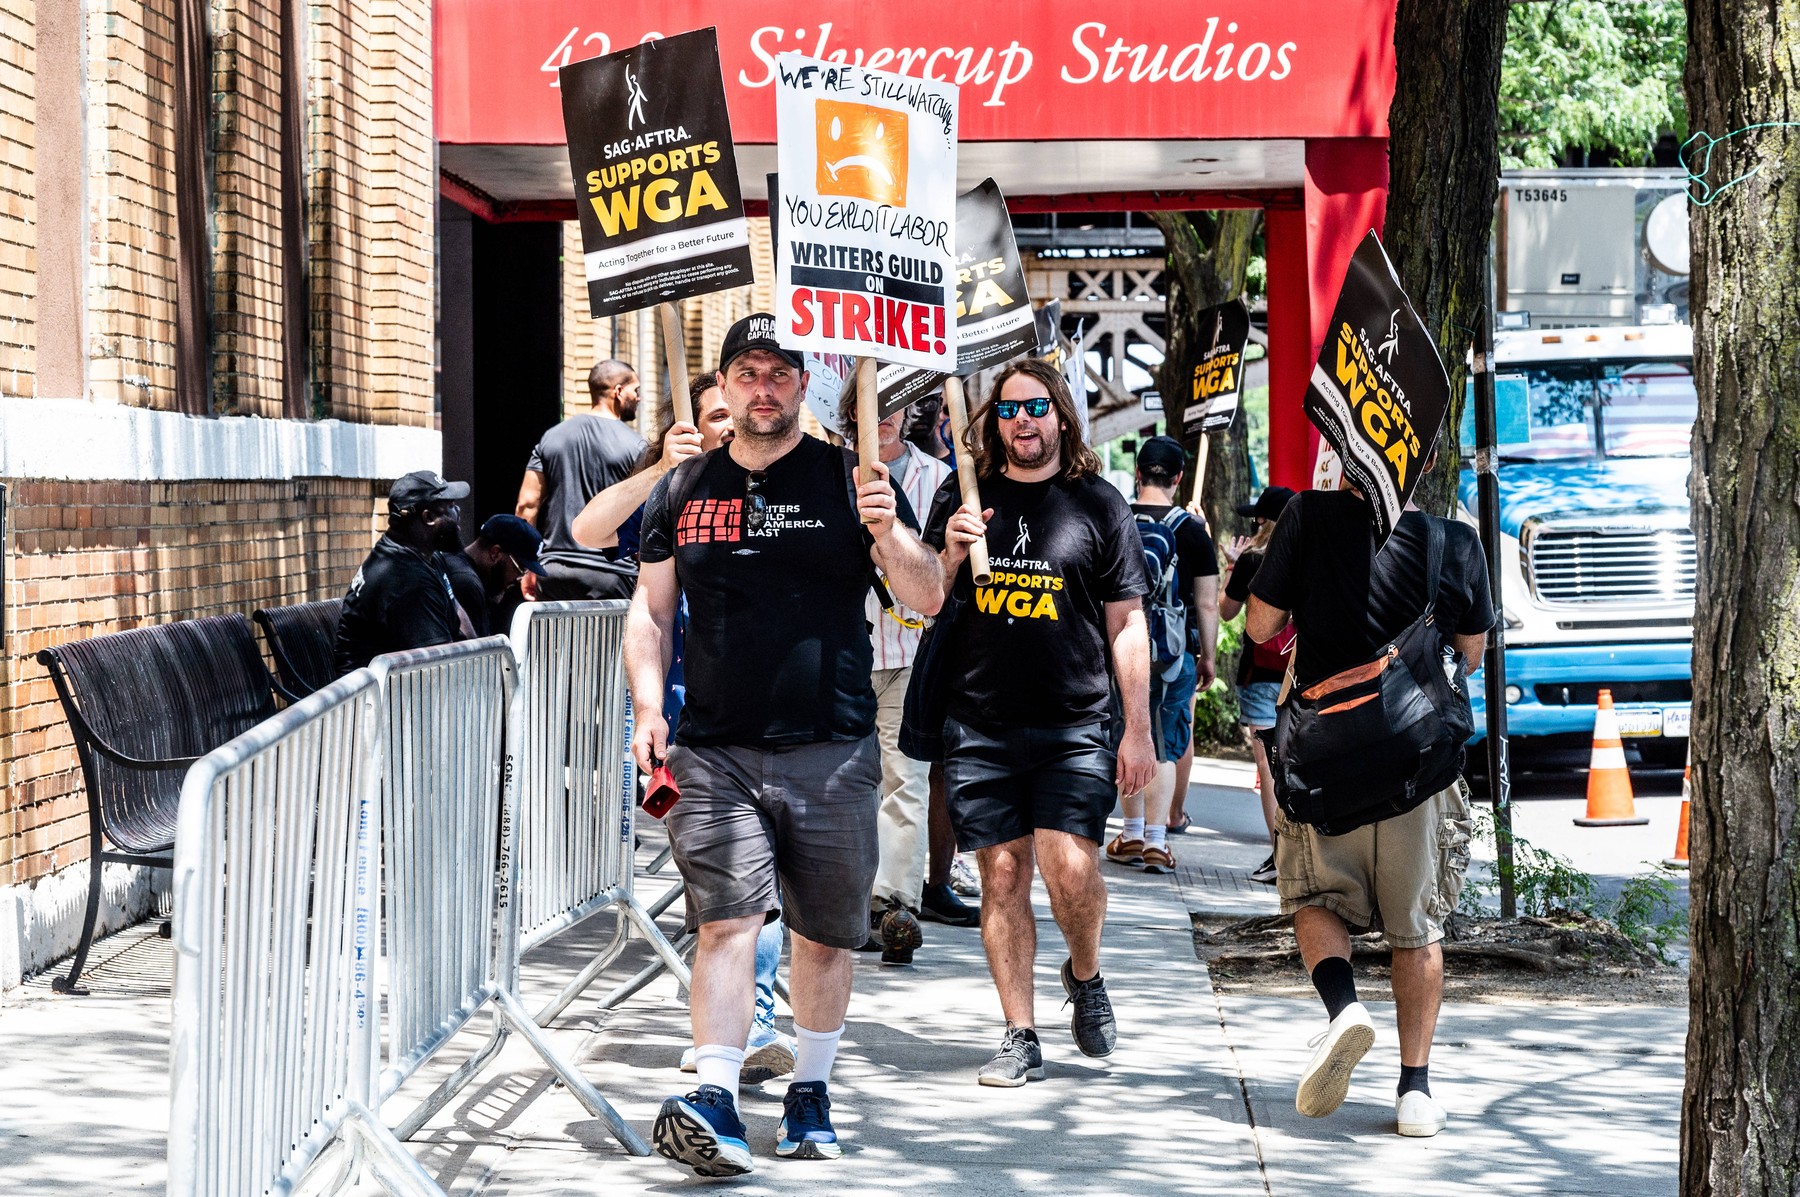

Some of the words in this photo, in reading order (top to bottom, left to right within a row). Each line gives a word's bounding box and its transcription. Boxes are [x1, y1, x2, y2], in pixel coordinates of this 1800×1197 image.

[739, 23, 1032, 107] Slercup
[1061, 17, 1297, 84] Studios
[779, 61, 855, 92] WE'RE
[861, 72, 907, 101] STILL
[586, 140, 721, 194] SUPPORTS
[589, 169, 729, 238] WGA
[1516, 189, 1567, 202] T53645
[785, 194, 822, 227] YOU
[825, 201, 892, 233] EXPLOIT
[890, 212, 951, 257] LABOR
[598, 256, 625, 269] Acting
[626, 248, 654, 263] Together
[655, 244, 668, 254] for
[678, 238, 704, 250] Better
[706, 230, 735, 244] Future
[790, 240, 884, 274] WRITERS
[888, 253, 943, 285] GUILD
[865, 275, 884, 294] ON
[749, 317, 776, 332] WGA
[791, 287, 947, 356] STRIKE!
[961, 328, 989, 339] Better
[991, 316, 1021, 332] Future
[880, 366, 906, 383] Acting
[1193, 366, 1235, 400] WGA
[1340, 322, 1421, 458] SUPPORTS
[1336, 337, 1409, 492] WGA
[1321, 381, 1341, 408] Acting
[1355, 441, 1365, 454] for
[1371, 458, 1386, 484] Better
[1385, 484, 1395, 512] Future
[760, 504, 801, 514] ITERS
[763, 520, 825, 529] AMERICA
[748, 528, 780, 537] EAST
[990, 571, 1064, 592] PPORTS
[975, 587, 1059, 621] WGA
[623, 718, 633, 753] Fence
